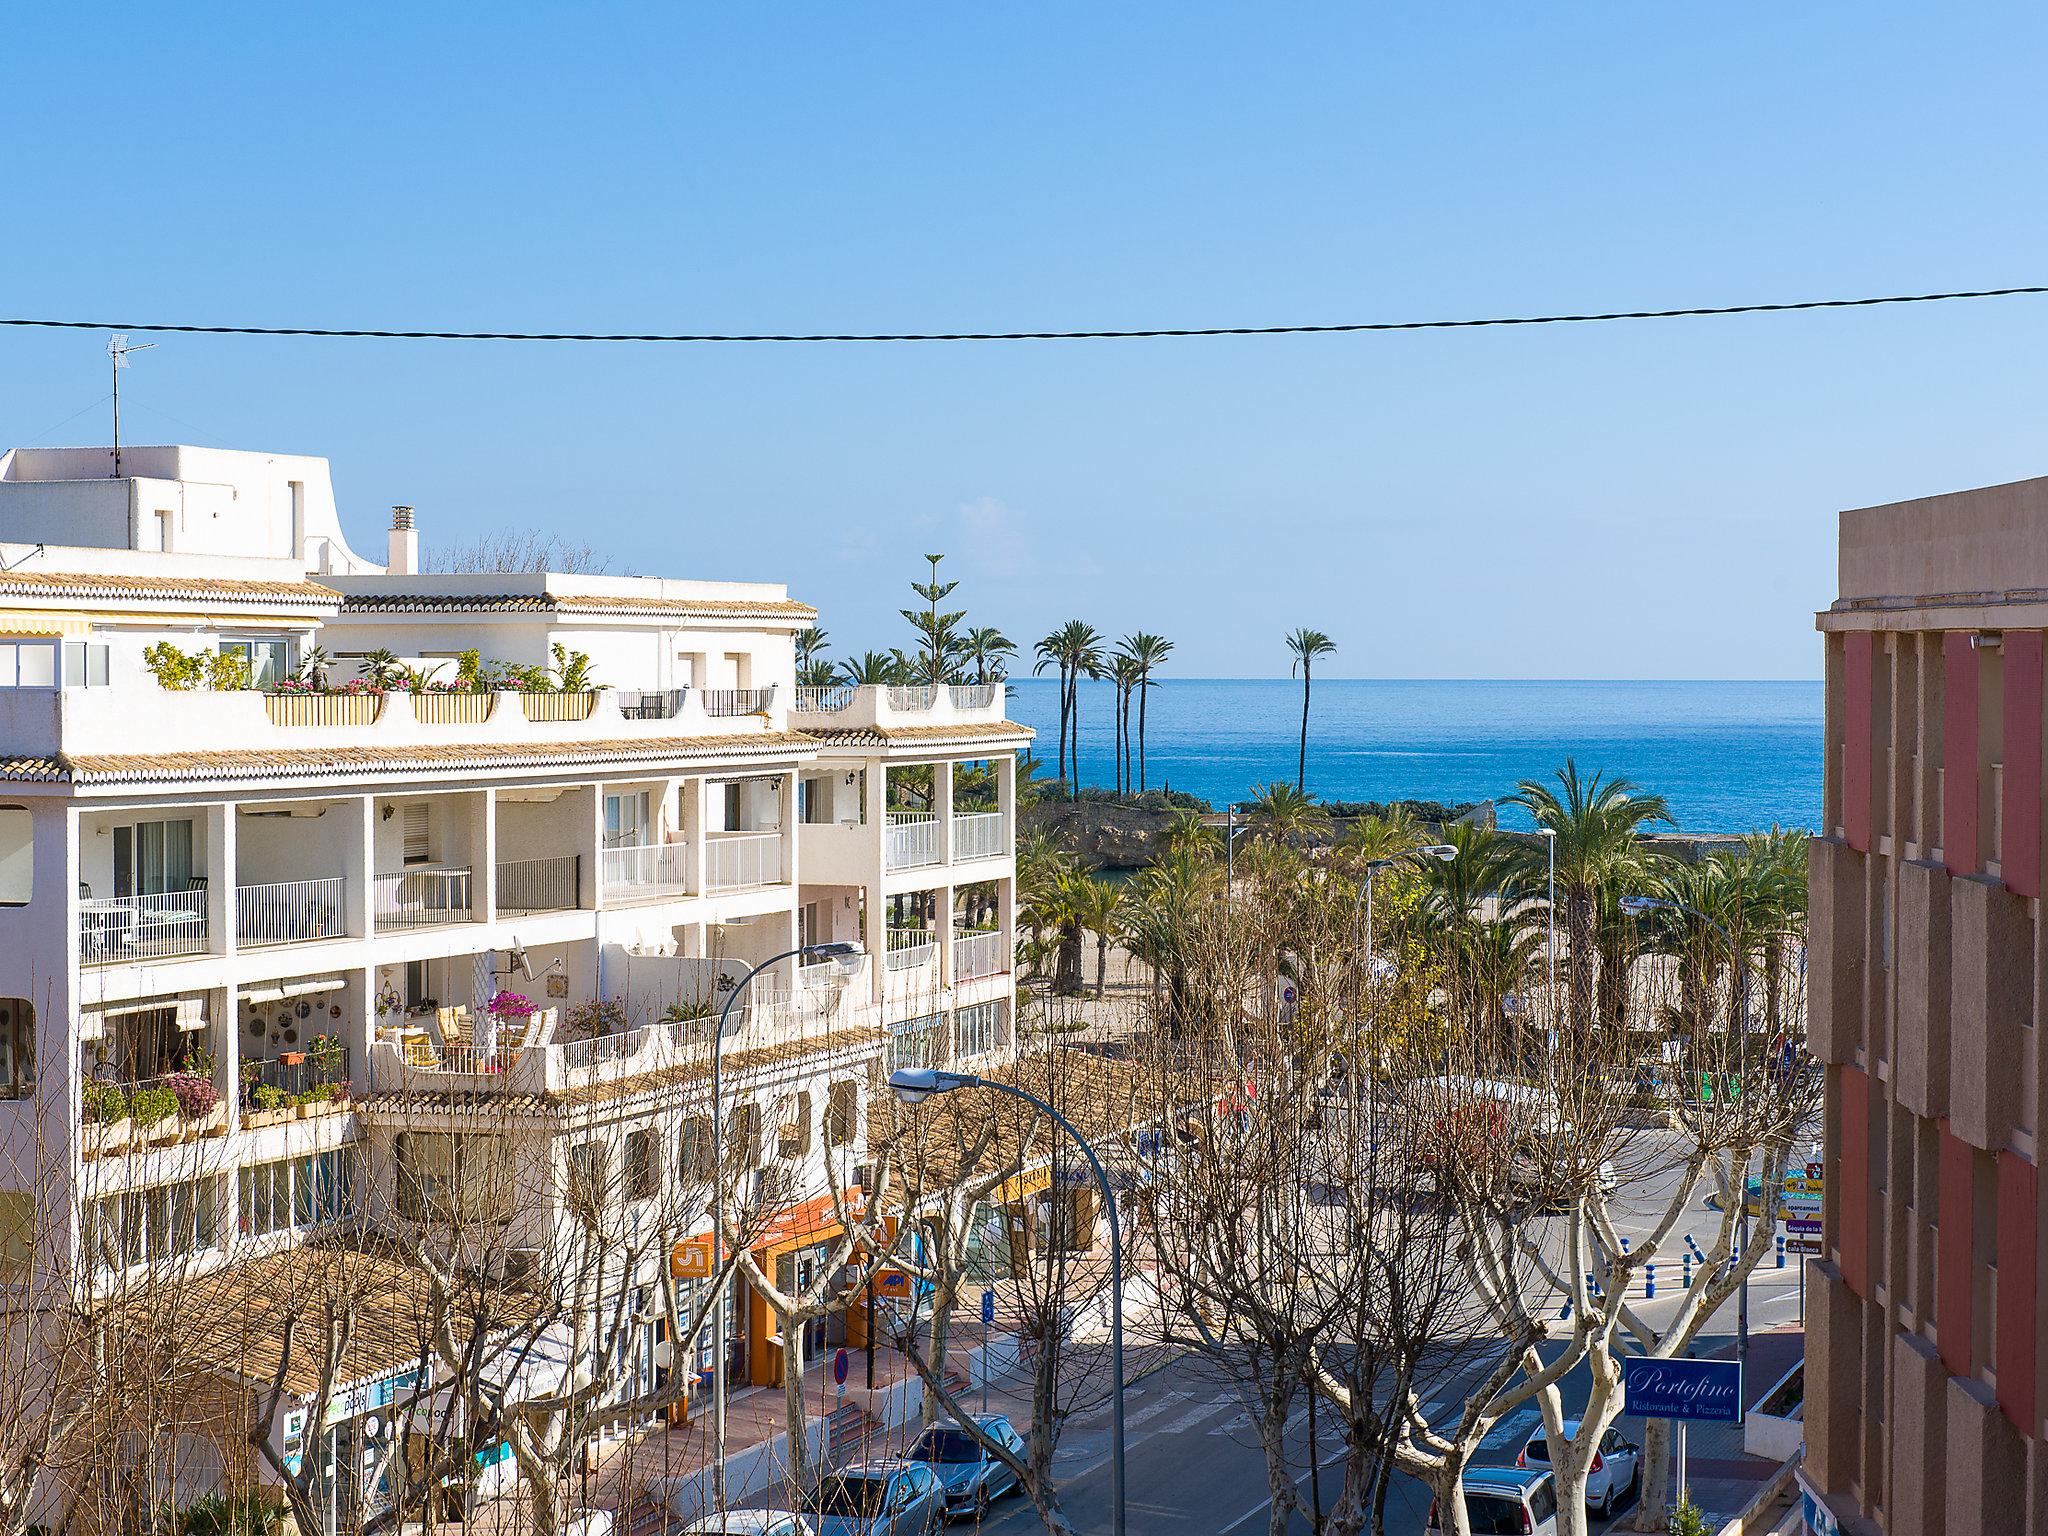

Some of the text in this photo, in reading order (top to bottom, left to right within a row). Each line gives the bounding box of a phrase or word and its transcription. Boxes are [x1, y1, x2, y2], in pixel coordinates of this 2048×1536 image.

[1628, 1365, 1735, 1403] Portofino
[1632, 1400, 1731, 1416] Ristorante & Pizzeria
